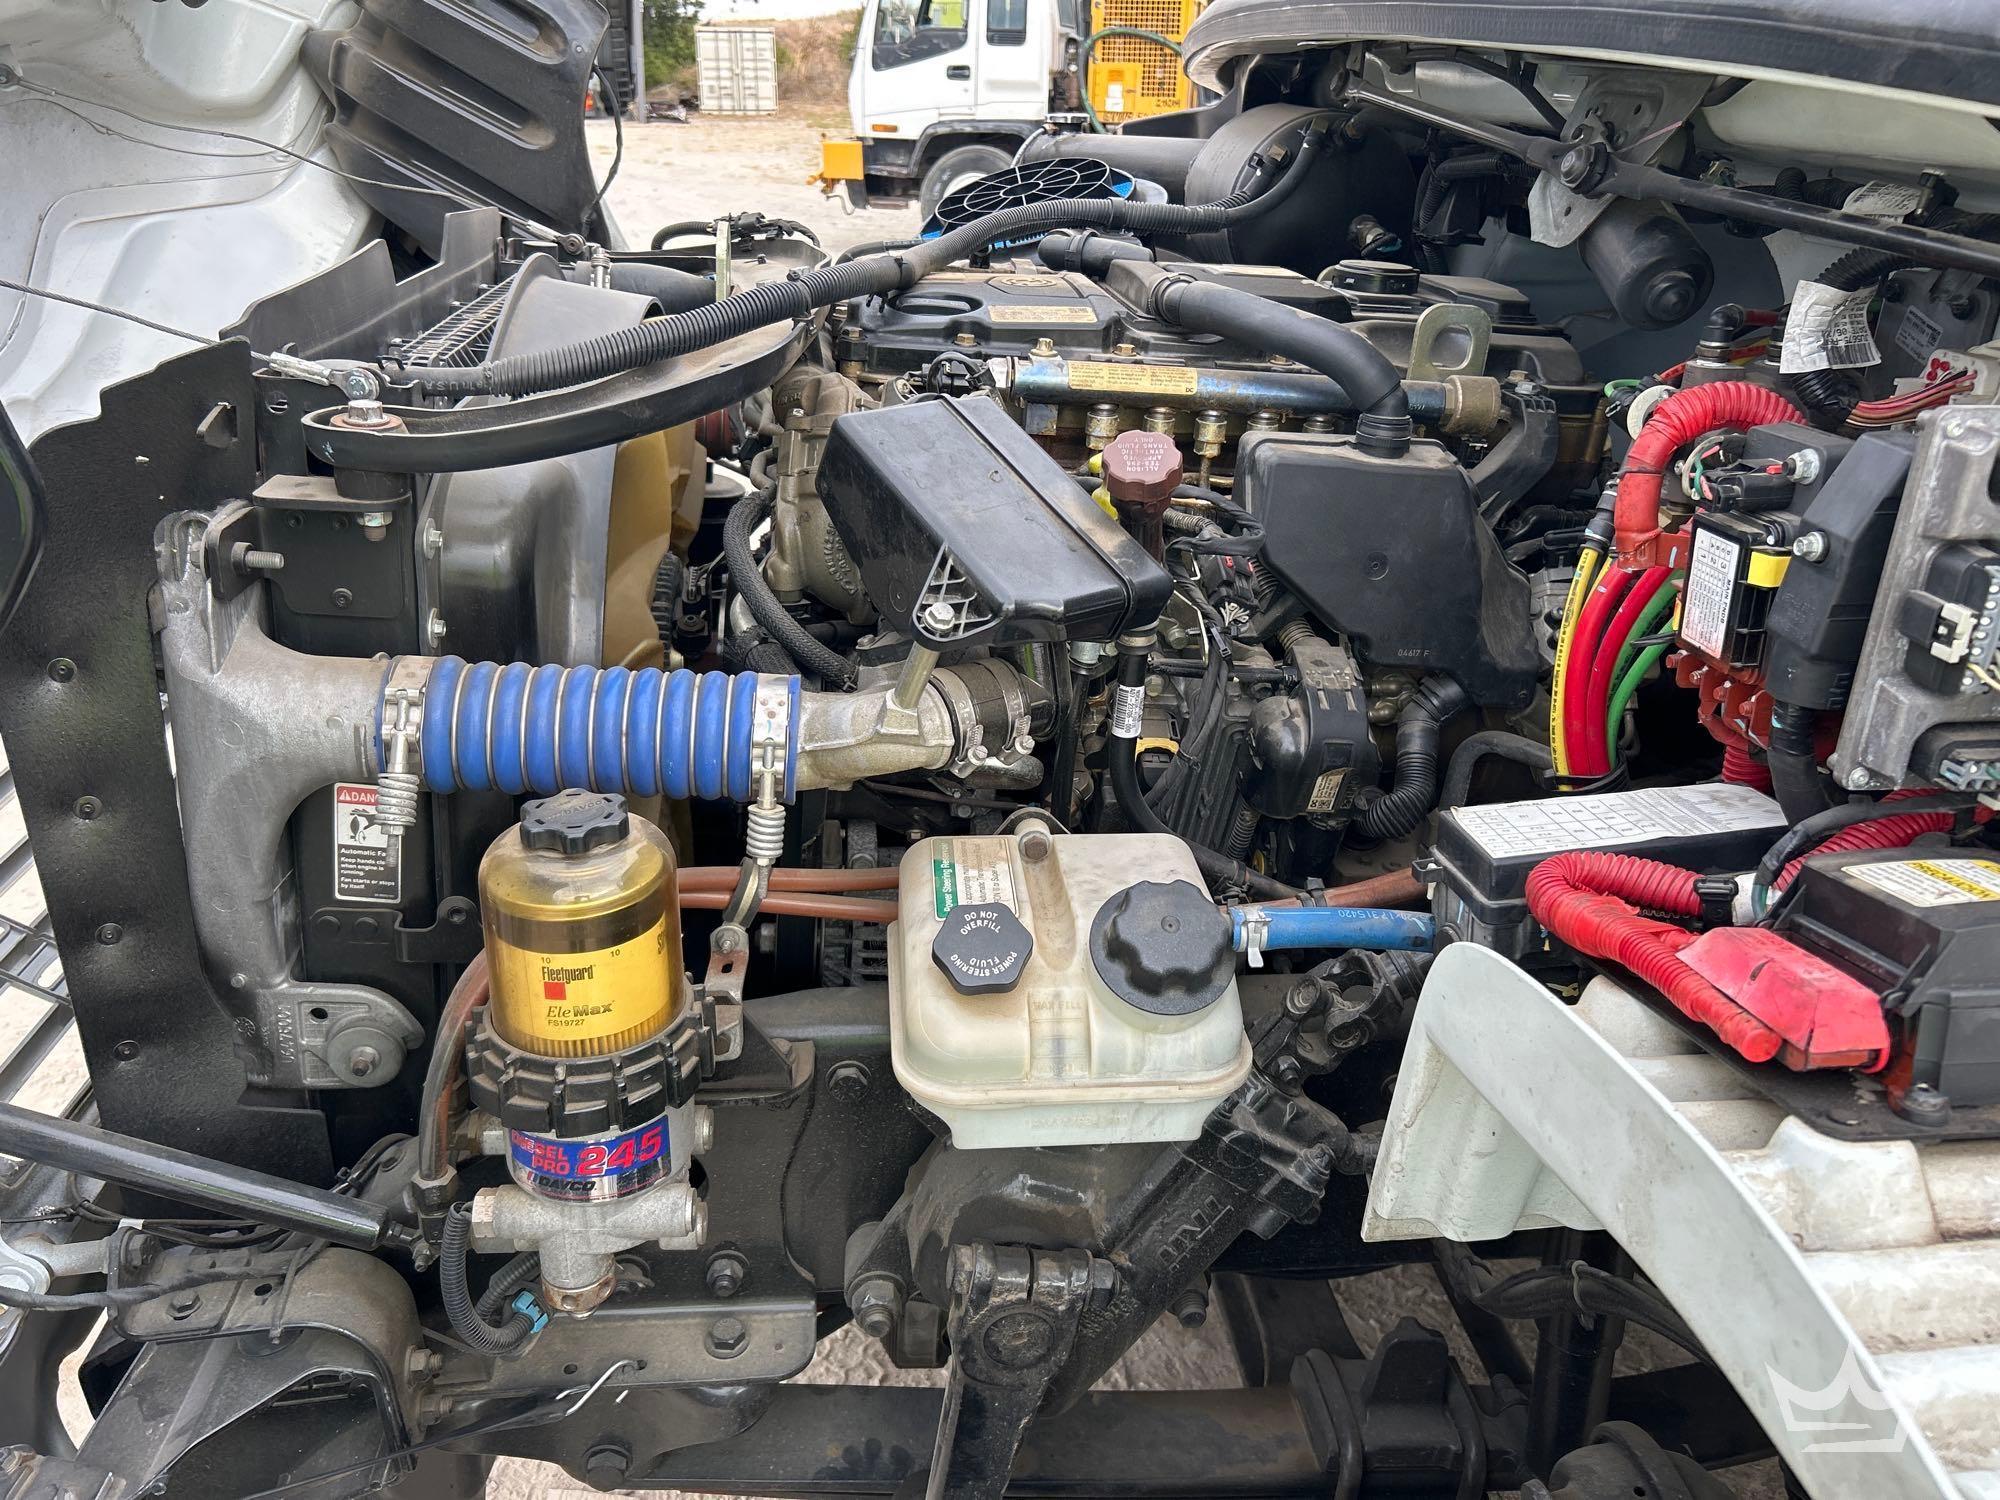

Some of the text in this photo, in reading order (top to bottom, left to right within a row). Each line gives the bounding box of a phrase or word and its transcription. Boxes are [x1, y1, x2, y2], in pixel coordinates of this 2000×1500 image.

[351, 791, 380, 803] DAN
[340, 847, 387, 858] Automatic Fa
[340, 857, 356, 865] Keep
[942, 869, 953, 893] Steering
[963, 910, 998, 922] DO NOT
[960, 919, 1002, 935] OVERFILL
[610, 949, 621, 958] 10
[541, 956, 551, 964] 10
[950, 951, 1018, 977] POWER STEERING
[969, 956, 1000, 967] FLUID
[541, 964, 594, 985] Fleetguard
[547, 1018, 585, 1027] FS19727
[511, 1125, 663, 1177] DIESEL 245
[532, 1155, 570, 1175] PRO
